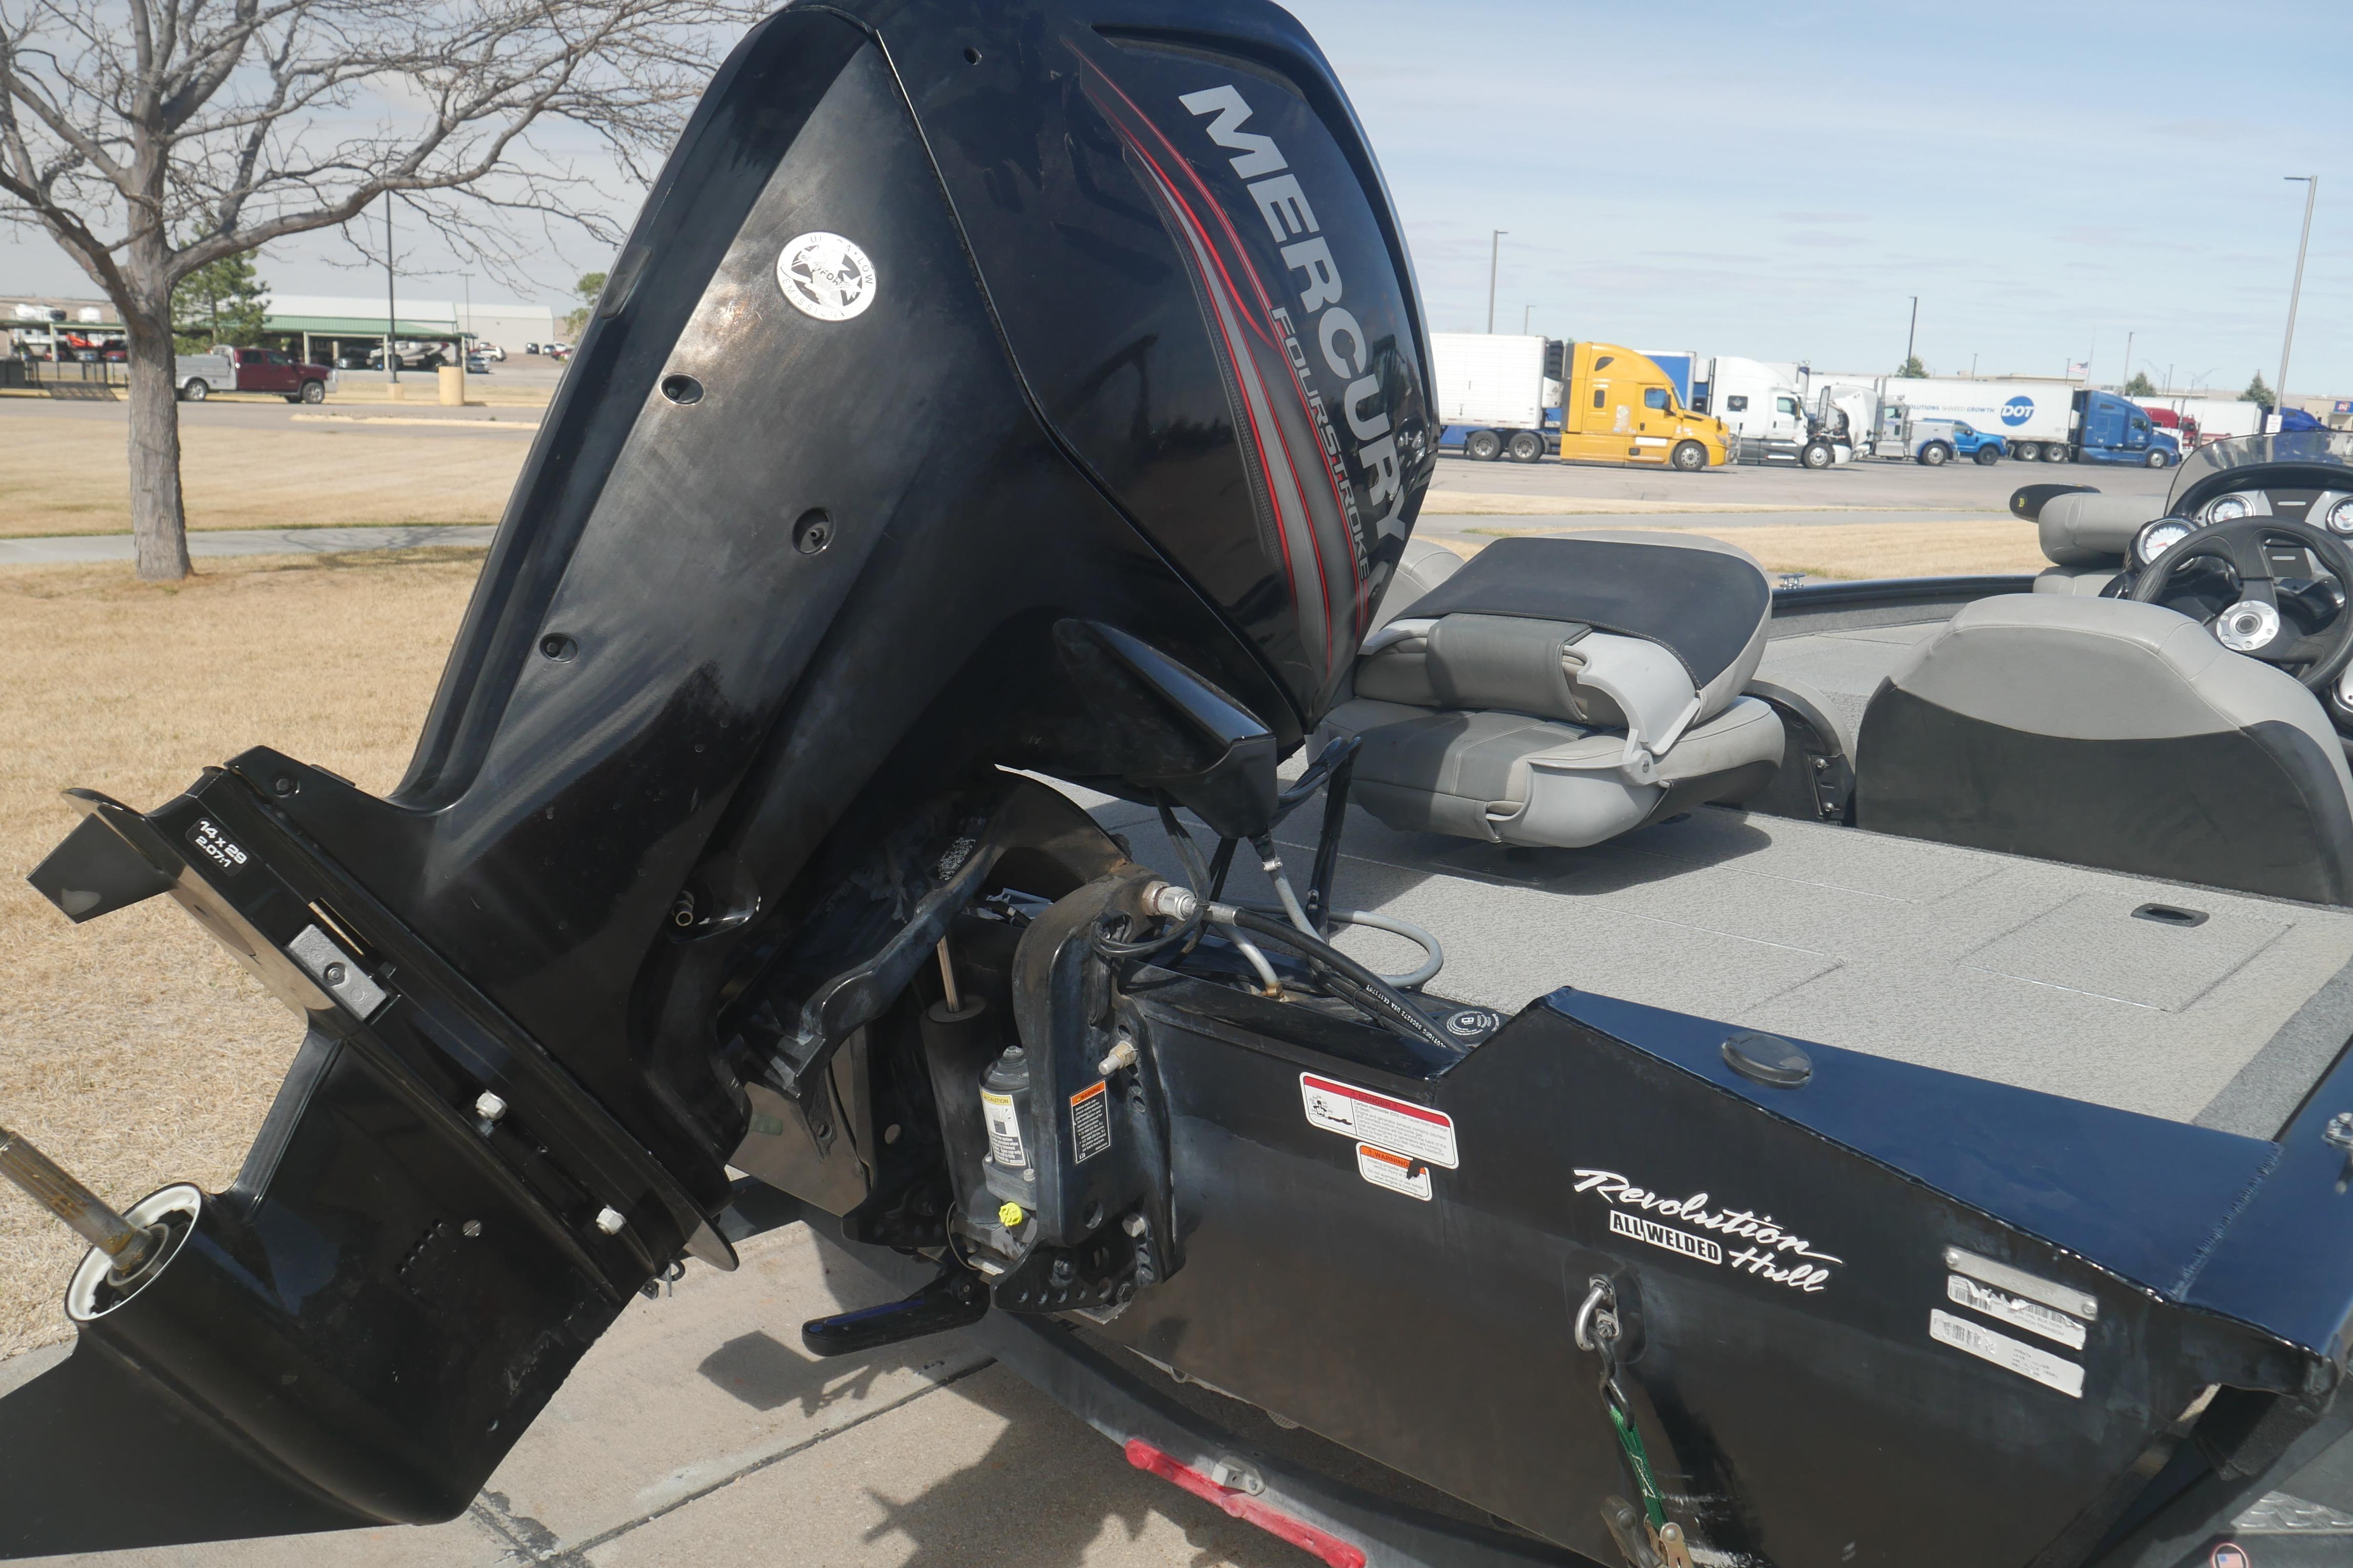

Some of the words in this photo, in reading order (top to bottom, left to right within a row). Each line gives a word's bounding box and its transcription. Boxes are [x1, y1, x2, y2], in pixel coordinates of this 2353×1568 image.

[858, 258, 873, 284] LOW
[1179, 85, 1406, 543] MERCURY
[2001, 405, 2034, 417] DOT
[1271, 307, 1369, 580] FOURSTROKE
[195, 835, 232, 867] 2.07:1
[200, 821, 218, 838] 14
[215, 837, 226, 847] x
[224, 844, 247, 864] 29
[1081, 1086, 1101, 1099] WARNING
[1358, 1094, 1391, 1107] DANGER
[1374, 1151, 1408, 1167] WARNING
[1573, 1169, 1844, 1265] Revolution
[1613, 1213, 1644, 1238] ALL
[1645, 1223, 1719, 1261] WELDED
[1728, 1246, 1830, 1292] Hull
